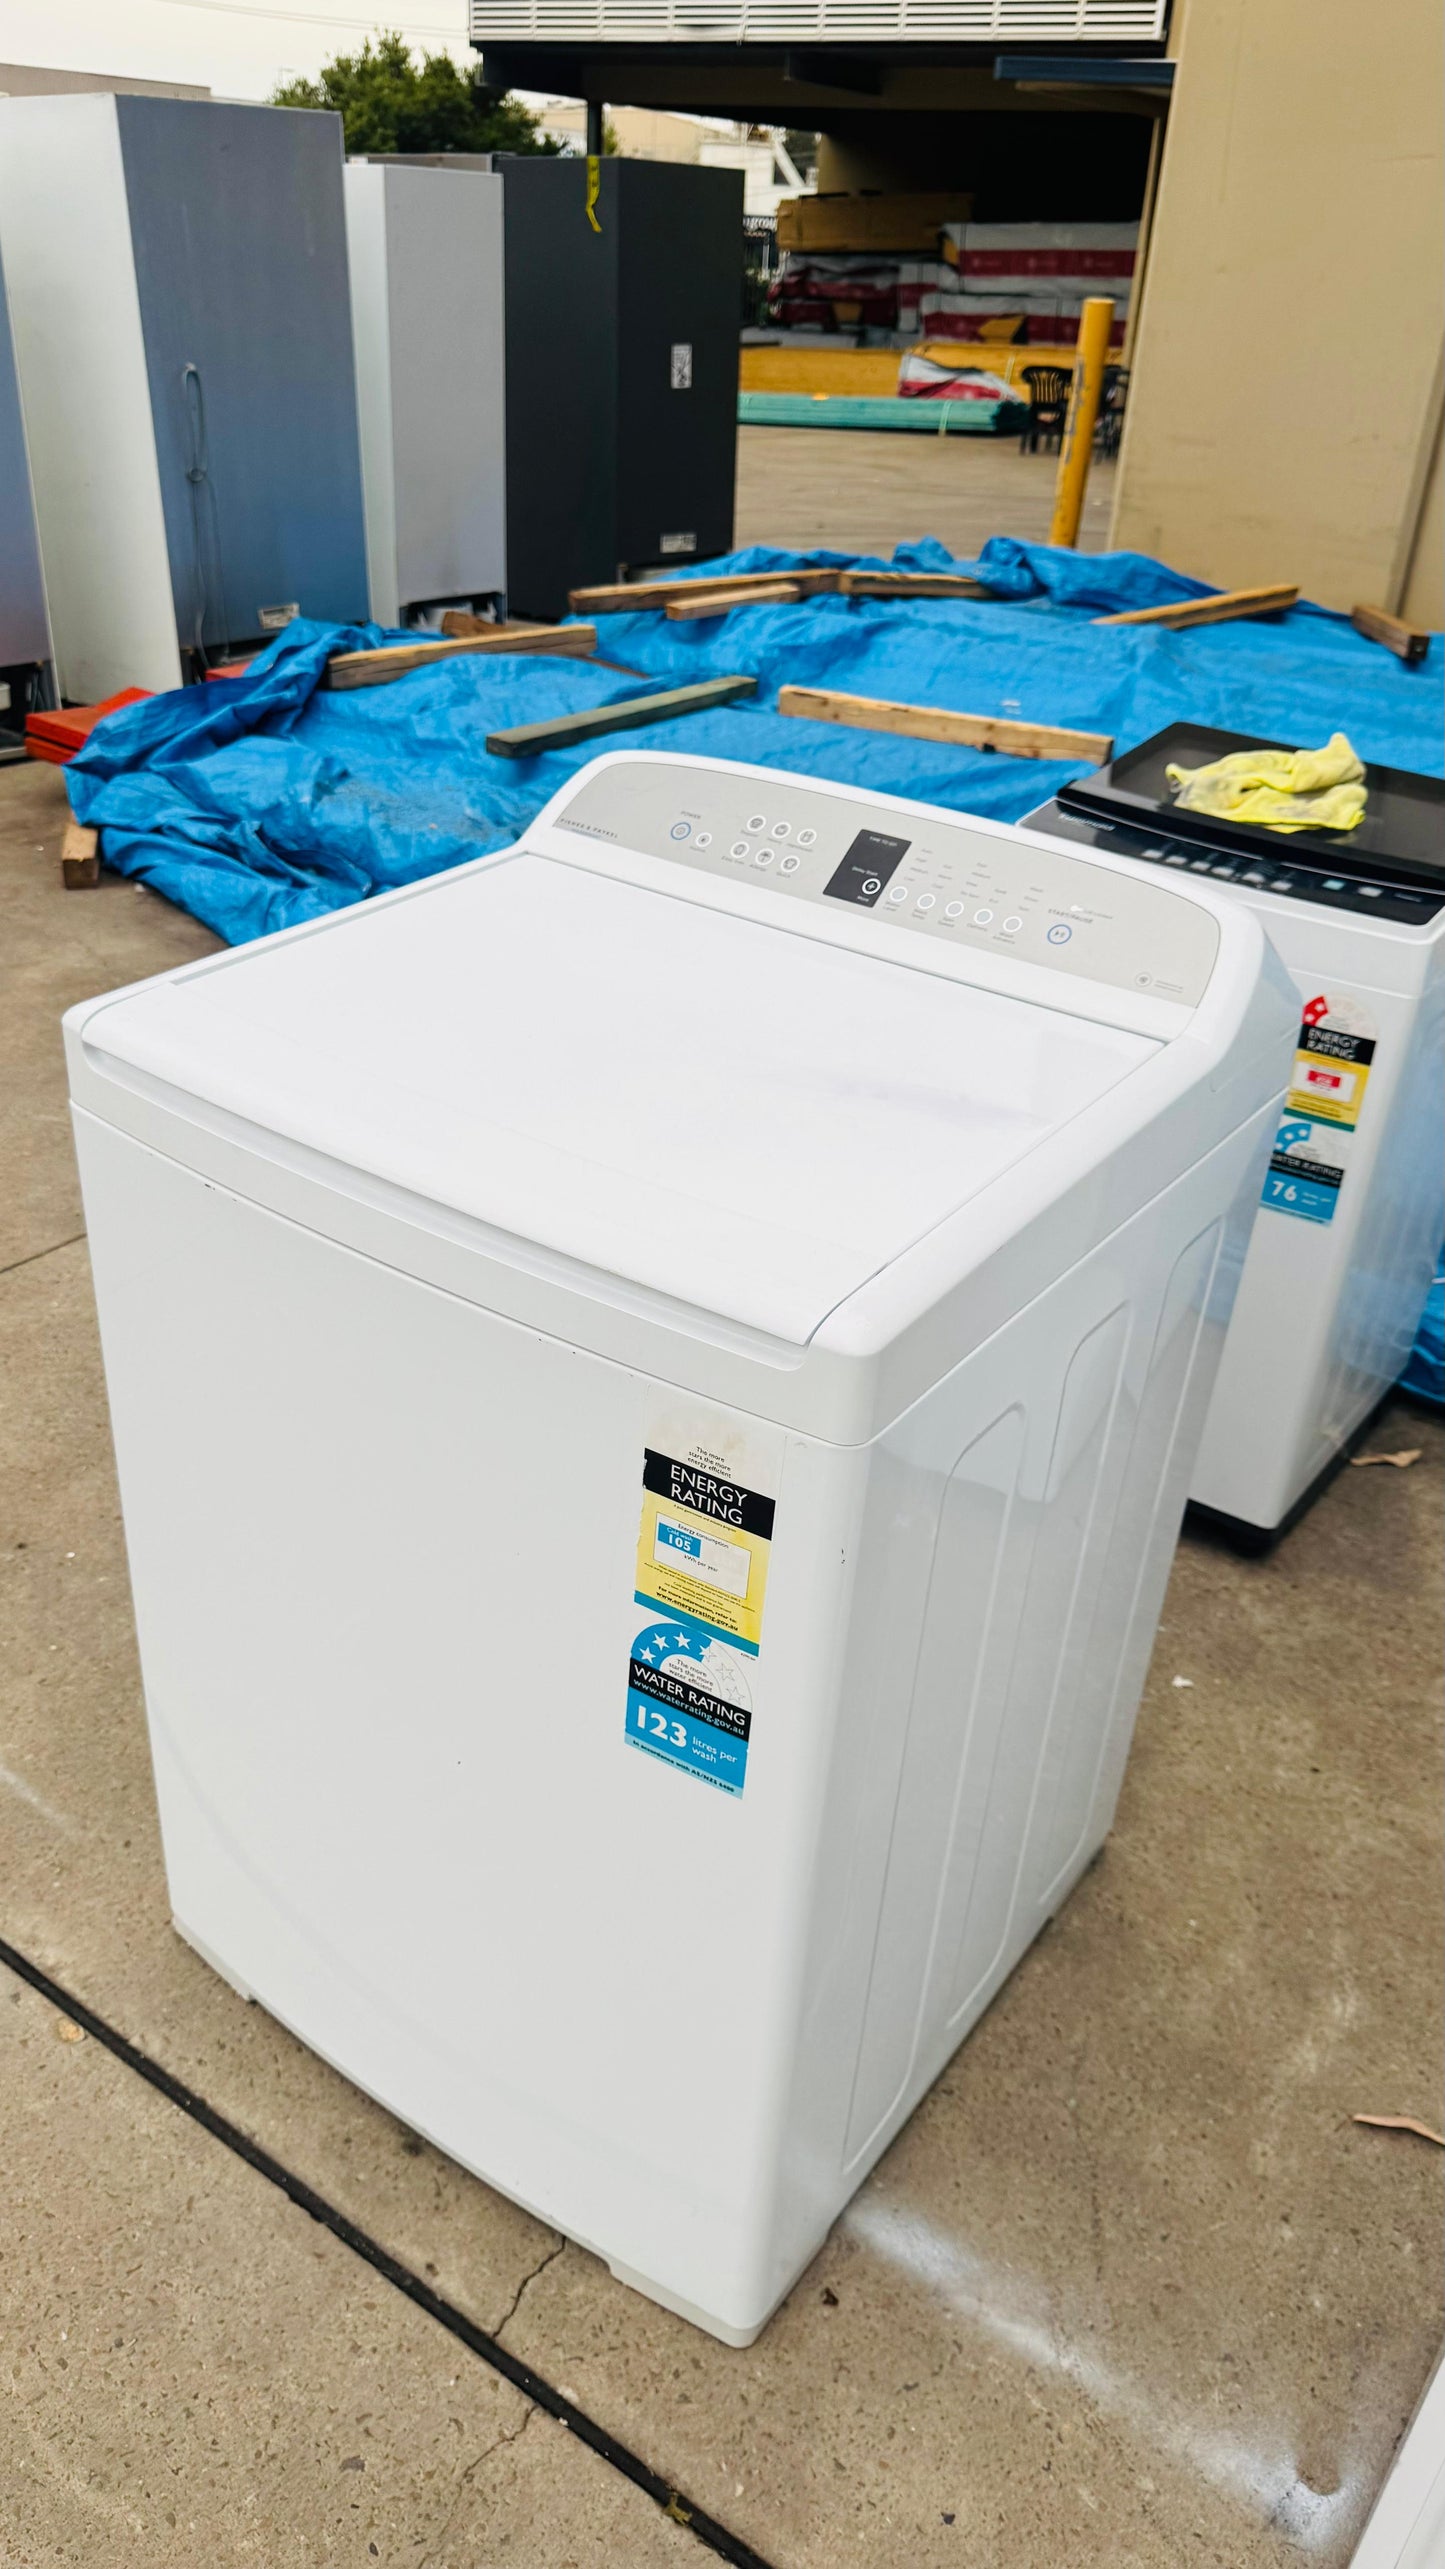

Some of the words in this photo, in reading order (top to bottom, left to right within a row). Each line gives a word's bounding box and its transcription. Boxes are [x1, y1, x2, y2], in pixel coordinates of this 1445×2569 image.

[560, 818, 584, 829] FISHER
[1307, 1040, 1354, 1059] RATING
[1308, 1029, 1360, 1048] ENERGY
[1272, 1181, 1296, 1201] 76
[689, 1451, 702, 1460] stars
[704, 1456, 714, 1464] the
[715, 1461, 731, 1471] more
[696, 1446, 707, 1456] The
[709, 1452, 724, 1462] more
[687, 1457, 707, 1469] energy
[708, 1465, 731, 1478] efficient
[671, 1464, 747, 1506] ENERGY
[671, 1483, 743, 1525] RATING
[667, 1527, 680, 1536] Cold
[669, 1534, 691, 1551] 105
[678, 1523, 695, 1535] Energy
[696, 1530, 729, 1548] consumption
[684, 1555, 697, 1563] kWh
[698, 1560, 706, 1569] per
[708, 1565, 718, 1573] year
[656, 1591, 738, 1631] www.energyrating.gov.au
[669, 1590, 681, 1599] more
[682, 1595, 714, 1614] information,
[715, 1609, 728, 1619] refer
[668, 1662, 683, 1673] stars
[685, 1669, 696, 1677] the
[697, 1675, 713, 1686] more
[677, 1659, 689, 1668] The
[690, 1665, 707, 1677] more
[669, 1669, 687, 1680] water
[688, 1677, 713, 1692] efficient
[634, 1664, 685, 1698] WATER
[688, 1691, 746, 1726] RATING
[634, 1679, 744, 1736] www.waterrating.gov.au
[637, 1705, 687, 1748] 123
[641, 1745, 675, 1764] accordance
[676, 1762, 690, 1771] with
[692, 1736, 717, 1754] litres
[720, 1751, 737, 1763] per
[692, 1747, 716, 1764] wash
